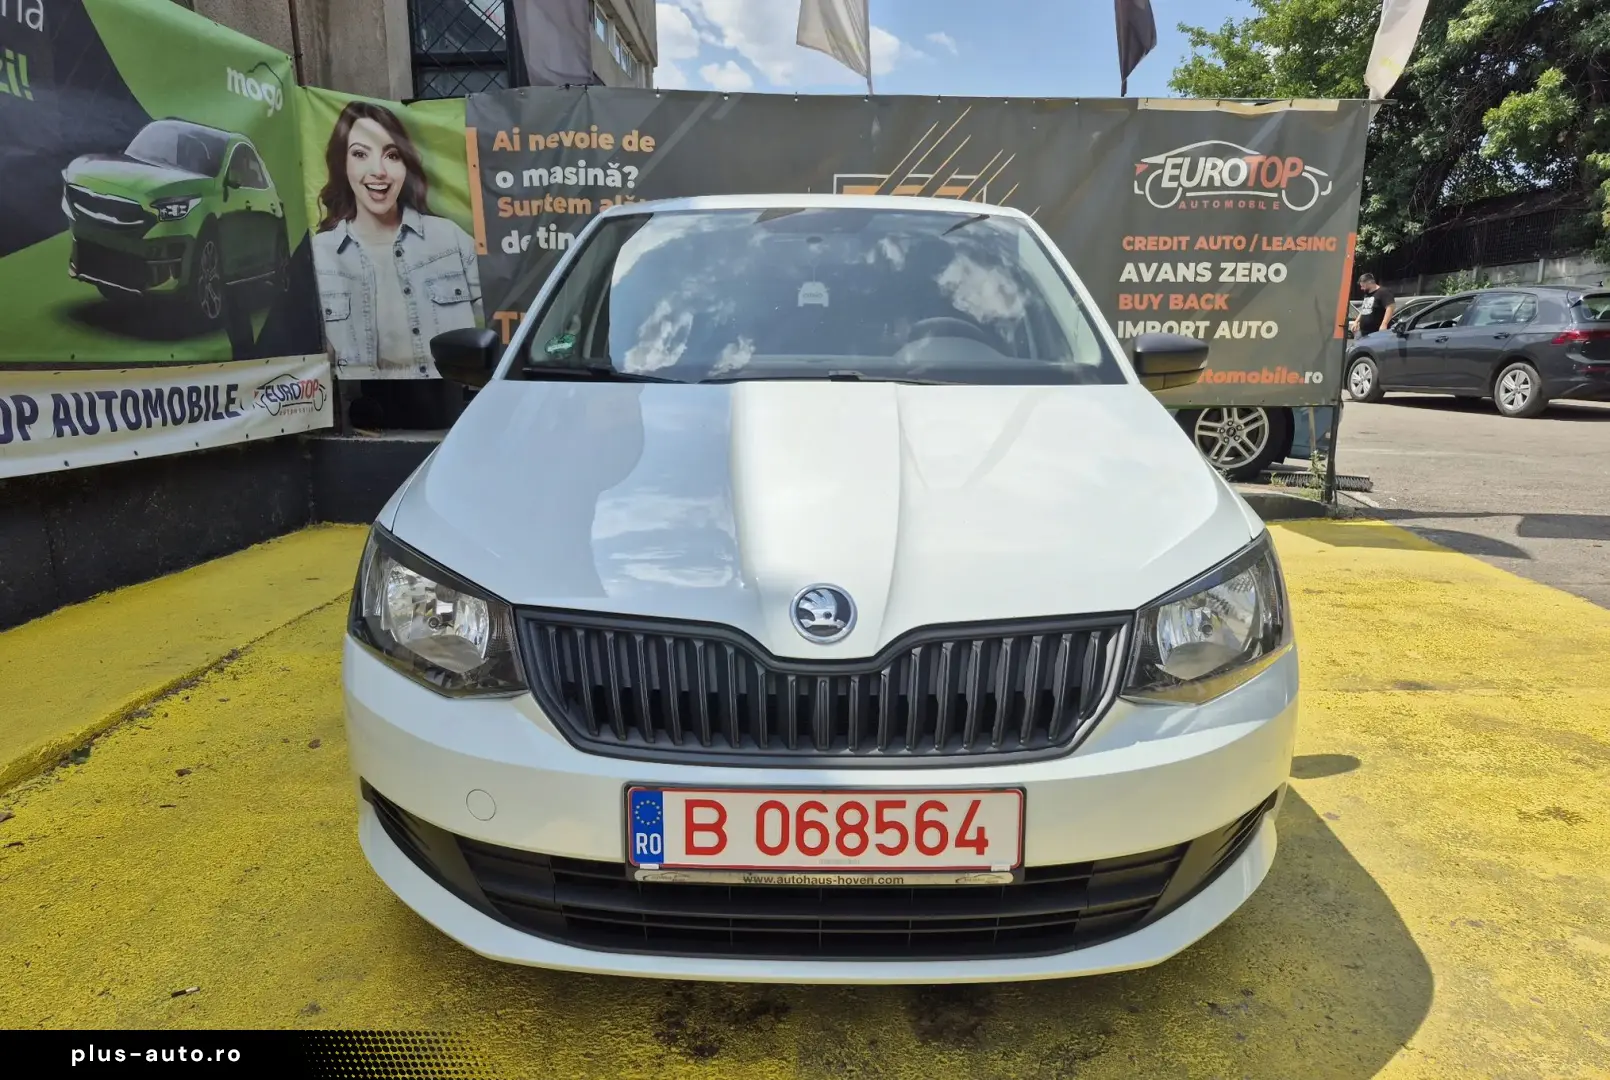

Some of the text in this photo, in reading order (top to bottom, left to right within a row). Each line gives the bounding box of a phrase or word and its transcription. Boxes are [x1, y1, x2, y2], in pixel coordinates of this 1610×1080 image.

[226, 67, 284, 117] mogo
[493, 125, 656, 152] Ai nevoie de
[496, 170, 514, 188] o
[1161, 155, 1304, 189] EUROTOP
[1178, 200, 1281, 211] AUTOMOBILE
[537, 223, 577, 250] tin
[1122, 235, 1190, 251] CREDIT
[1194, 235, 1247, 251] AUTO
[1262, 236, 1337, 252] LEASING
[1119, 262, 1288, 283] AVANS ZERO
[1118, 293, 1230, 310] BUY BACK
[1117, 321, 1279, 339] IMPORT AUTO
[1197, 366, 1324, 384] tomobile.ro
[265, 379, 319, 403] EUROTOP
[51, 384, 242, 438] AUTOMOBILE
[684, 799, 990, 857] B 068564
[635, 832, 662, 855] RO
[743, 874, 904, 886] www.autohaus-hoven.com
